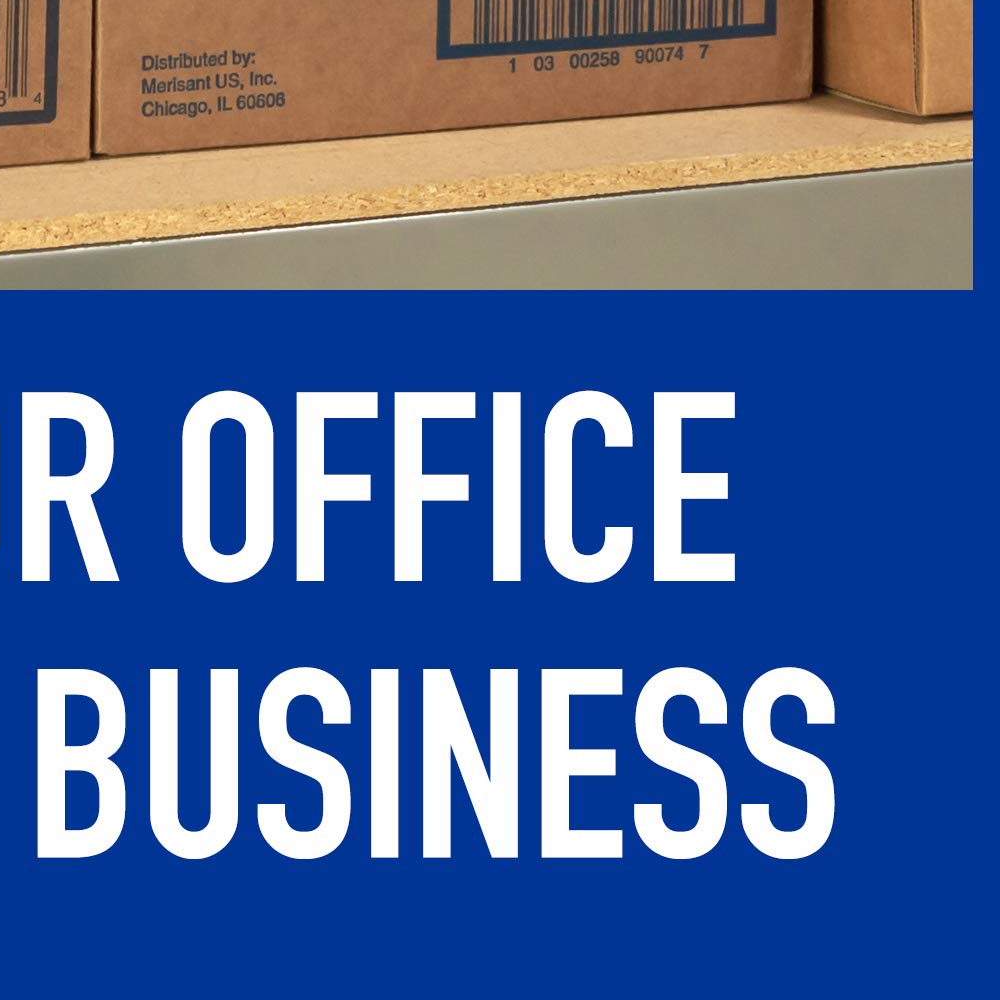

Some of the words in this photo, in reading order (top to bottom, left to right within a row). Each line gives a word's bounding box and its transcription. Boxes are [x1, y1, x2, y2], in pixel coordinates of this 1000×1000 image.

[141, 51, 228, 71] Distributed
[232, 50, 256, 68] by:
[509, 58, 516, 73] 1
[533, 56, 555, 72] 03
[569, 51, 621, 69] 00258
[635, 46, 684, 64] 90074
[699, 44, 709, 59] 7
[141, 75, 211, 94] Merisant
[215, 72, 244, 91] US,
[250, 71, 277, 86] Inc.
[33, 92, 42, 105] 4
[141, 100, 212, 118] Chicago,
[217, 96, 233, 112] IL
[236, 92, 286, 110] 60606
